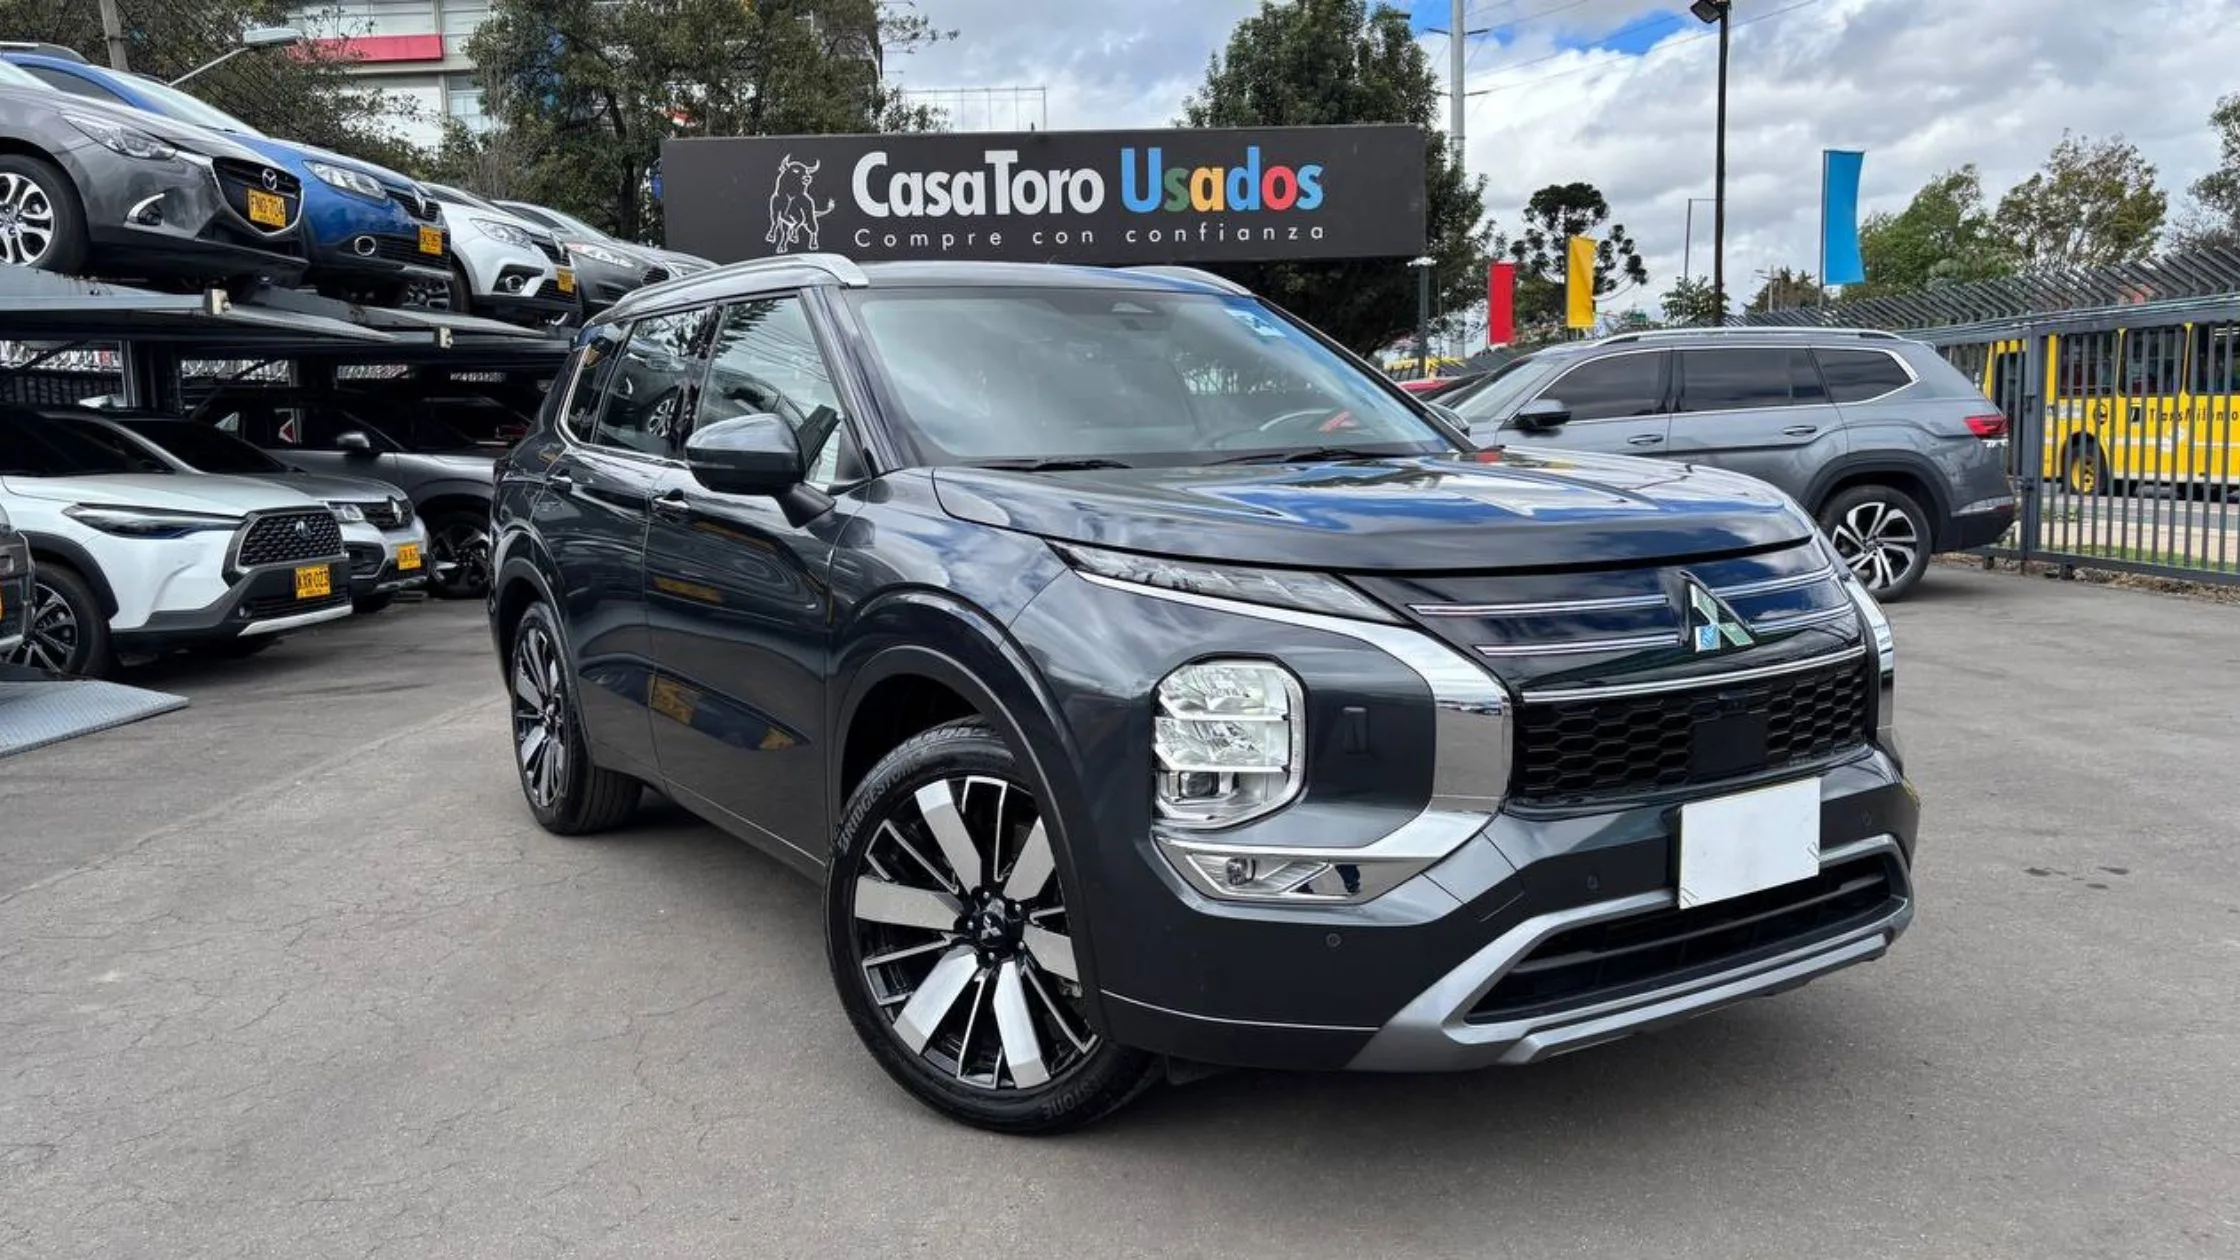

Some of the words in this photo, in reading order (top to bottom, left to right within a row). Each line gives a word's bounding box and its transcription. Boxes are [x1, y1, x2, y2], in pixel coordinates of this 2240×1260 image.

[851, 149, 1105, 217] CasaToro
[1120, 145, 1324, 213] Usados
[854, 228, 1002, 250] Compre
[1032, 230, 1093, 245] con
[1125, 221, 1324, 243] confianza
